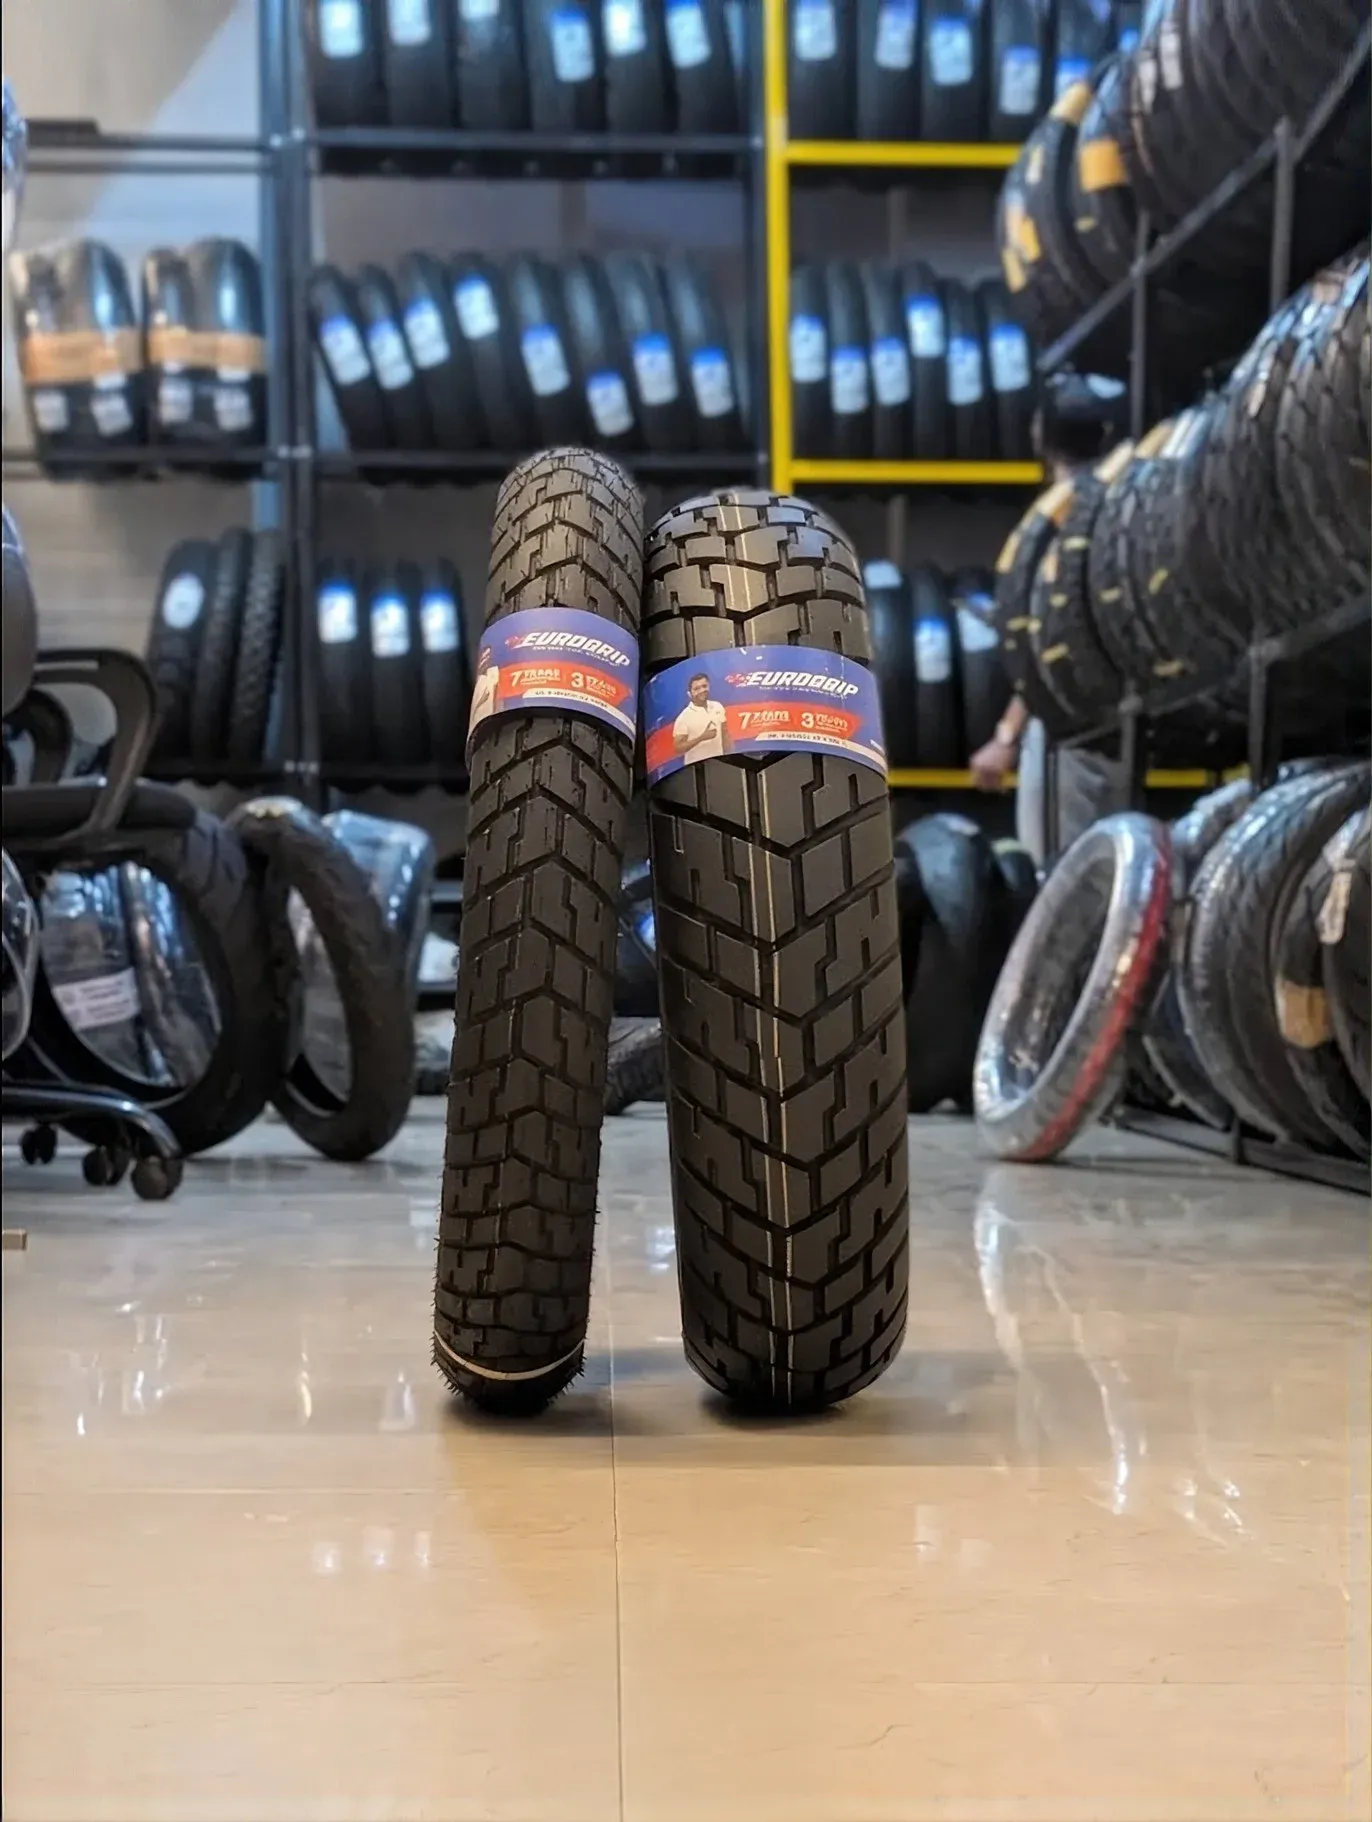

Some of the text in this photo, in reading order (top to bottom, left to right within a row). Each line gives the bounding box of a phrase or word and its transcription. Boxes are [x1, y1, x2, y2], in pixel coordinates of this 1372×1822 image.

[510, 670, 522, 687] 7
[571, 672, 584, 688] 3
[738, 711, 751, 730] 7
[801, 712, 814, 728] 3
